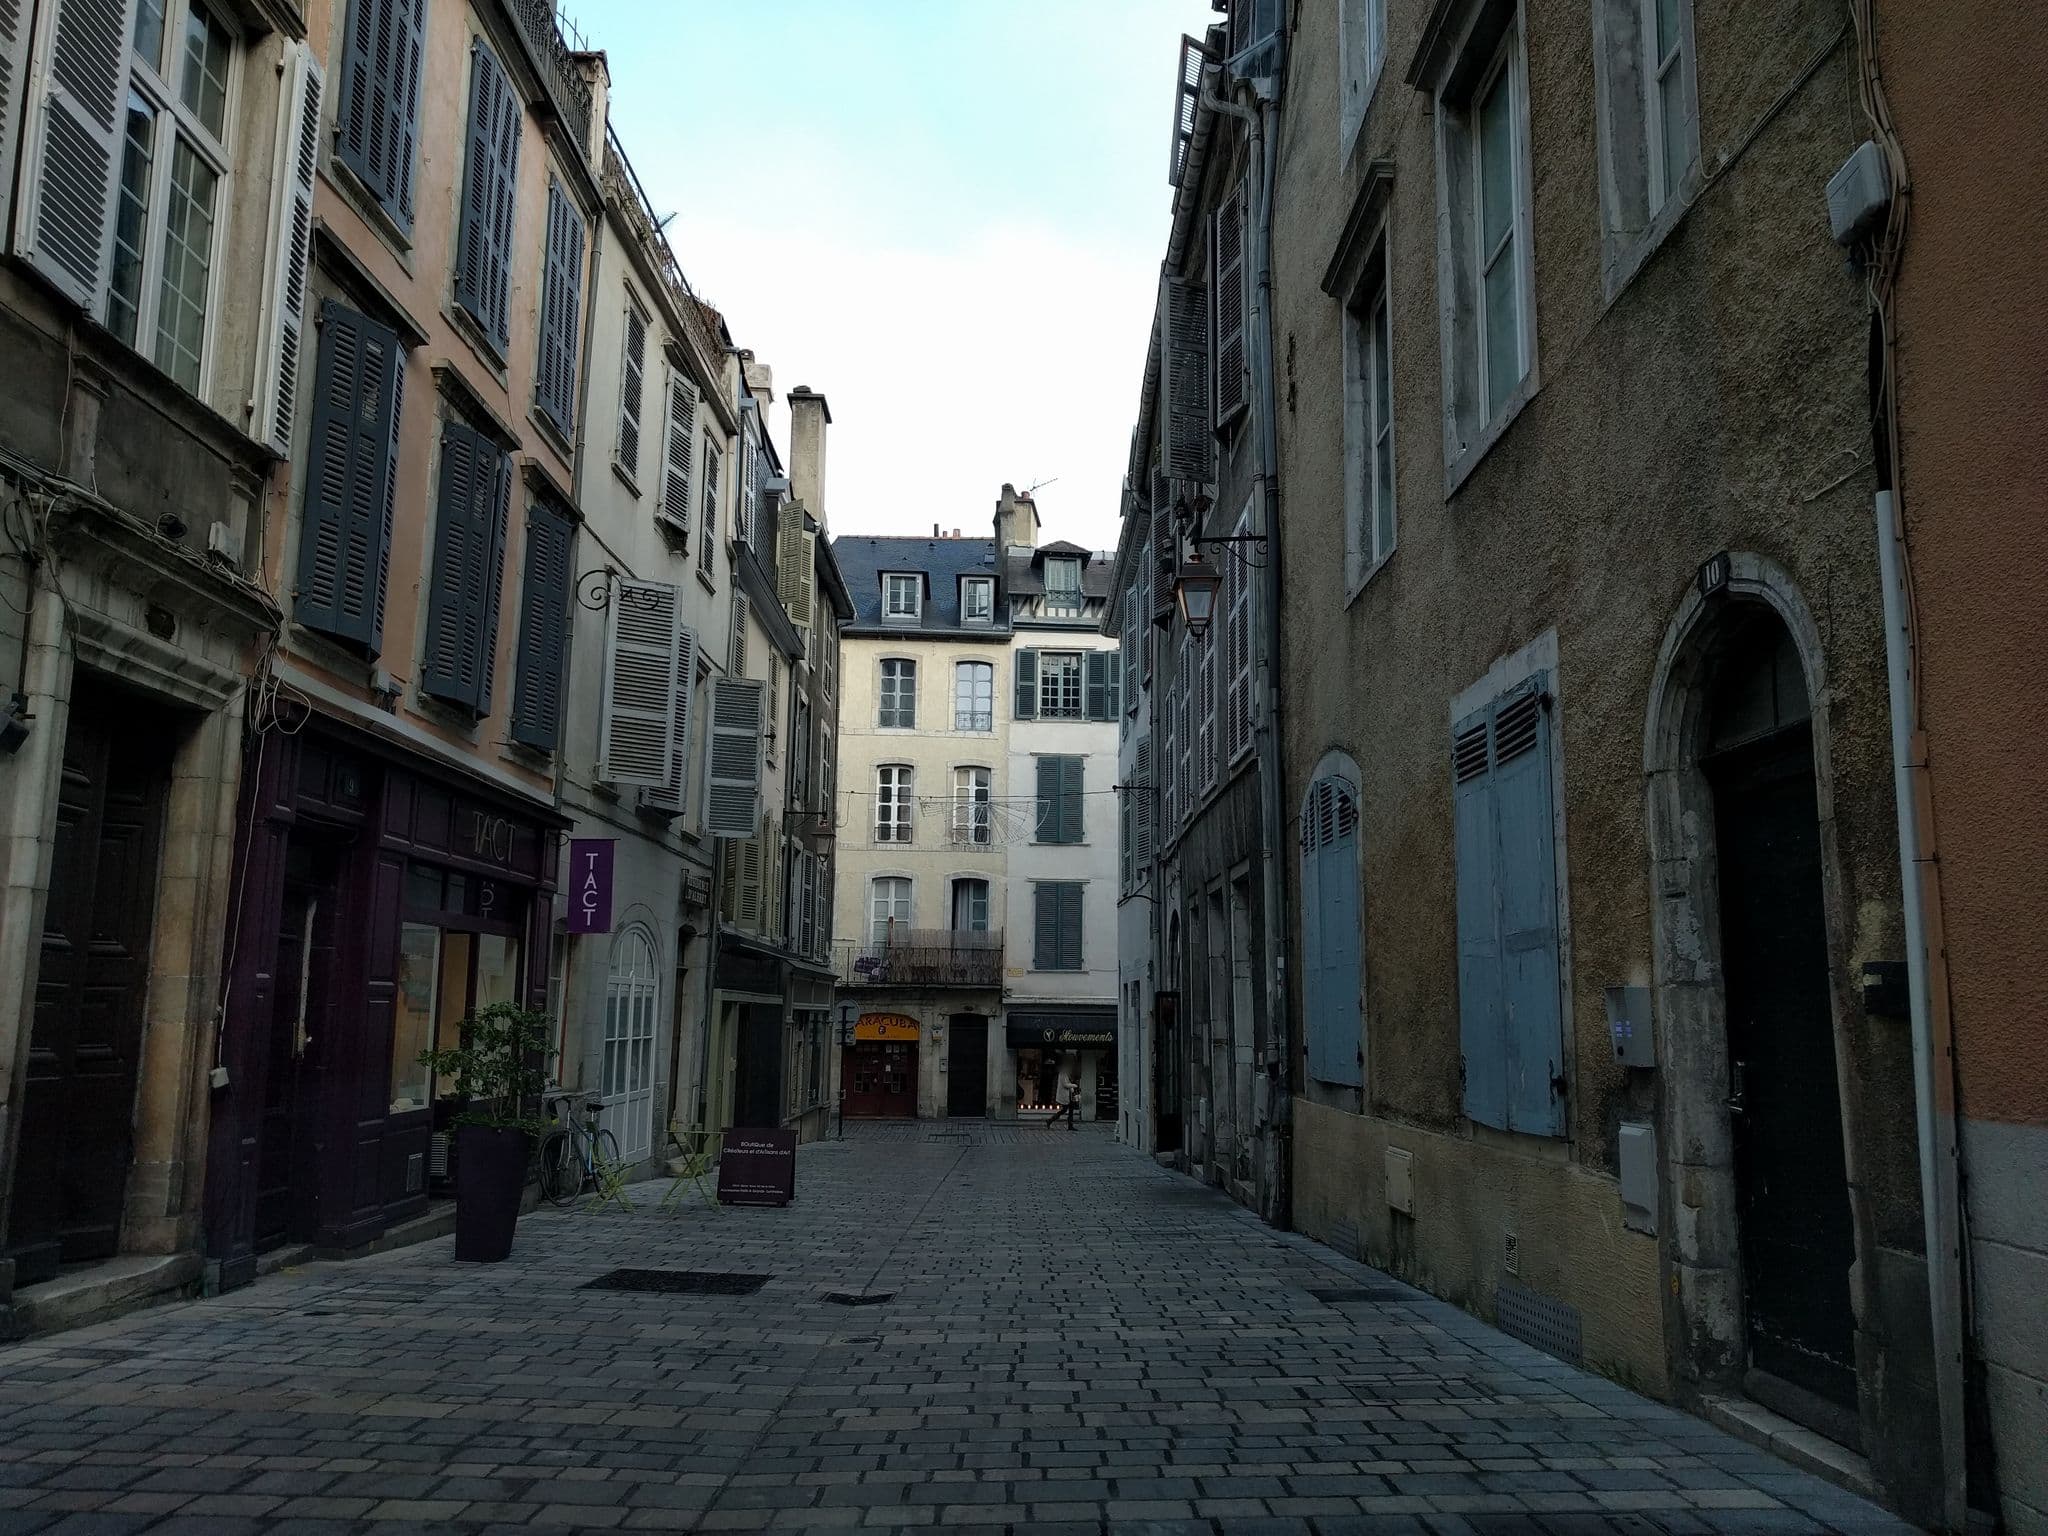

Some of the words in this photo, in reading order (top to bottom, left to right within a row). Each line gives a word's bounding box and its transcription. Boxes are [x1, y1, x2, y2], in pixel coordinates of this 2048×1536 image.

[1705, 560, 1720, 589] 10
[472, 809, 518, 864] TACT
[582, 852, 599, 927] TACT
[854, 1016, 919, 1032] ARACUBA
